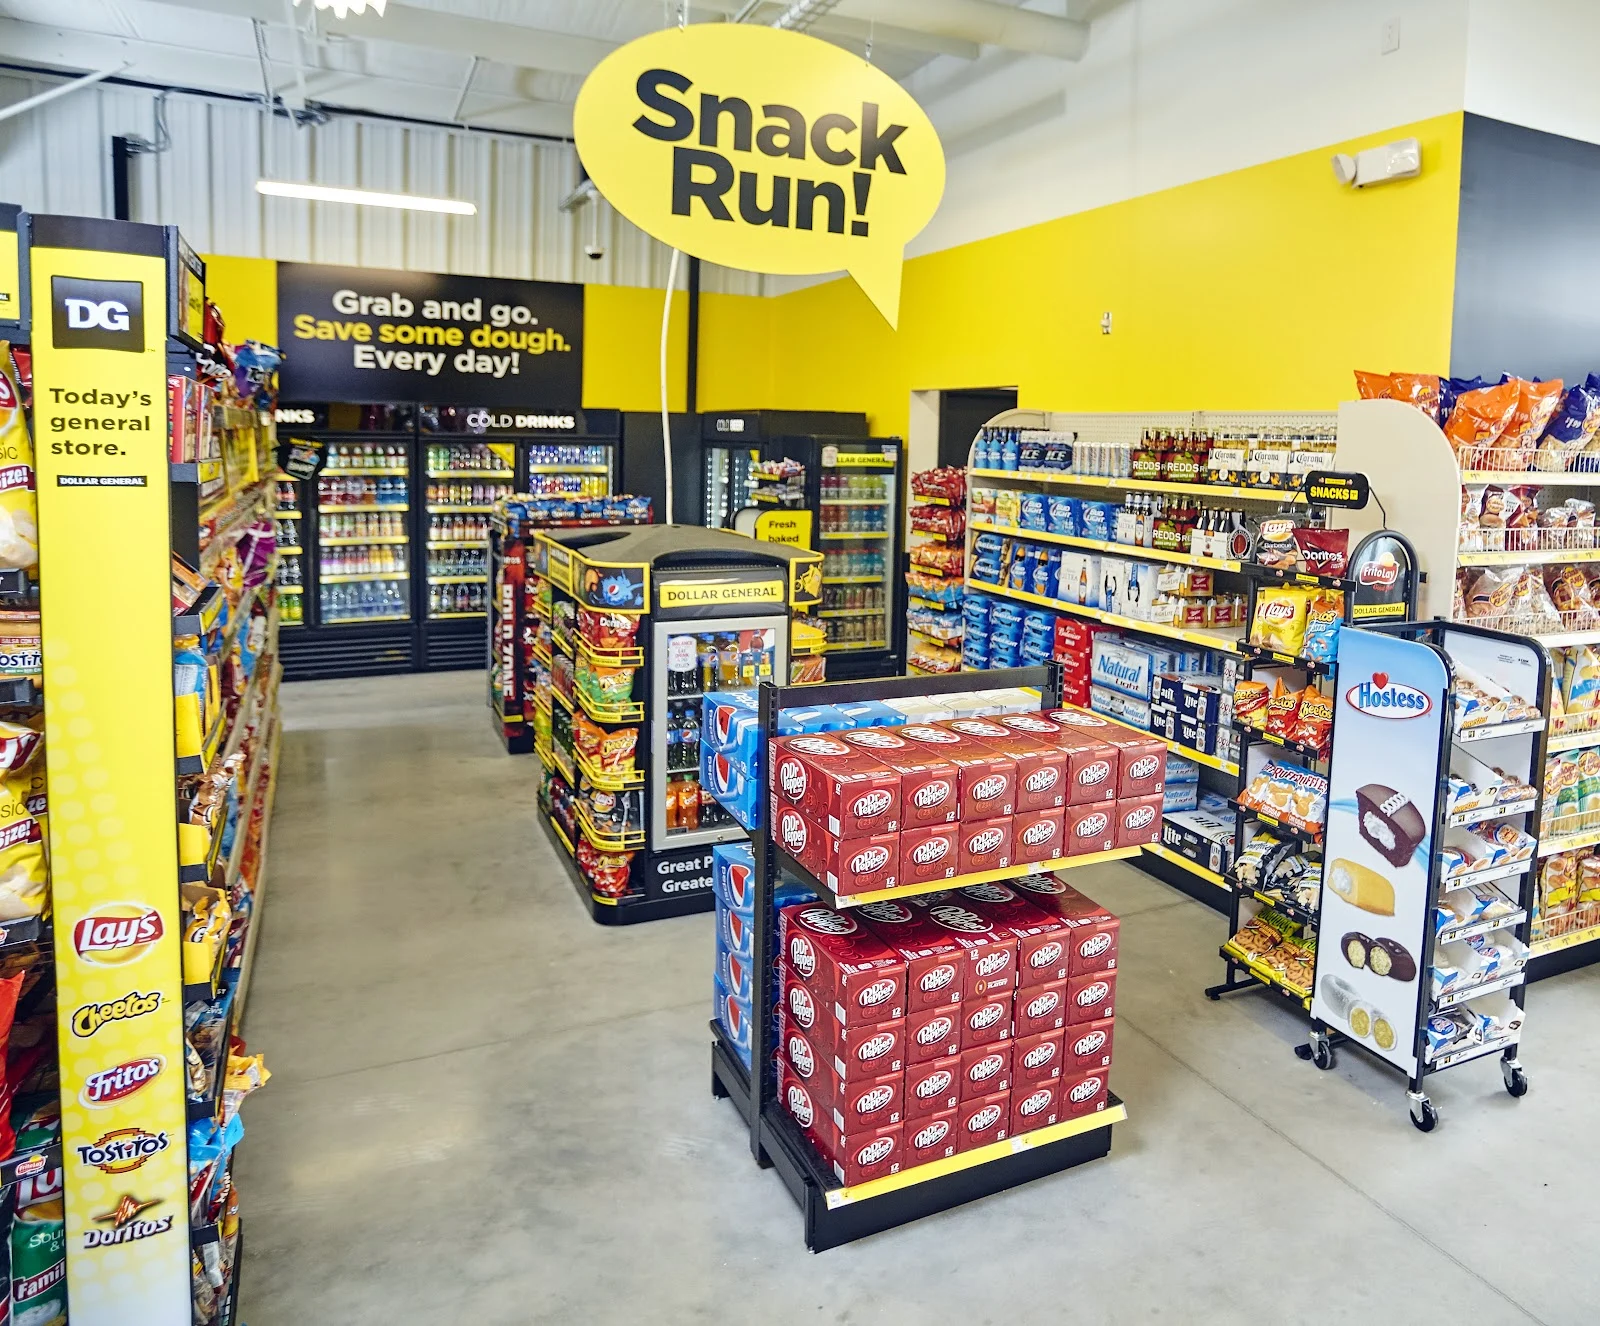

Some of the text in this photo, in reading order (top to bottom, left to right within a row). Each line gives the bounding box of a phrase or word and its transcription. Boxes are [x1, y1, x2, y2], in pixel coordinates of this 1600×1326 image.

[632, 69, 908, 175] Snack
[672, 146, 869, 238] Run!
[64, 297, 130, 331] DG
[332, 290, 538, 327] Grab and go.
[294, 314, 572, 355] Save some dough.
[353, 344, 520, 378] Every day!
[50, 388, 152, 408] Today's
[275, 408, 315, 424] NKS
[466, 413, 576, 430] COLD DRINKS
[50, 416, 150, 432] general
[51, 440, 126, 456] store.
[1020, 450, 1040, 460] ICE
[1044, 450, 1066, 460] ICE
[60, 476, 144, 486] DOLLAR GENERAL
[1310, 486, 1350, 500] SNACKS
[1026, 506, 1044, 514] LIGHT
[1027, 500, 1042, 508] BUD
[1054, 510, 1072, 518] LIGHT
[1087, 514, 1106, 522] LIGHT
[1089, 508, 1104, 516] BUD
[768, 520, 796, 529] Fresh
[768, 534, 799, 543] baked
[1264, 542, 1292, 550] Barbecue
[1302, 549, 1342, 562] Doritos
[668, 588, 777, 600] DOLLAR GENERAL
[1098, 654, 1142, 682] Natural
[1115, 678, 1140, 691] Light
[1160, 688, 1174, 700] Lite
[1359, 681, 1425, 710] Hostess
[1184, 696, 1198, 708] Lite
[1124, 706, 1146, 718] Natural
[1154, 716, 1166, 728] Lite
[1183, 728, 1196, 739] Lite
[1089, 765, 1100, 773] Dr
[1132, 760, 1156, 778] Pepper
[1140, 759, 1150, 767] Dr
[1081, 766, 1107, 784] Pepper
[926, 785, 939, 794] Dr
[976, 780, 1004, 799] Pepper
[984, 779, 996, 787] Dr
[867, 794, 880, 804] Dr
[917, 786, 947, 807] Pepper
[857, 796, 888, 817] Pepper
[888, 821, 897, 829] 12
[1035, 823, 1046, 832] Dr
[1027, 825, 1053, 844] Pepper
[1164, 826, 1182, 846] Lite
[657, 858, 701, 875] Great
[662, 877, 713, 893] Greate
[79, 912, 158, 951] Lay's
[1083, 938, 1109, 956] Pepper
[1091, 937, 1102, 945] Dr
[862, 985, 893, 1006] Pepper
[872, 983, 884, 993] Dr
[72, 992, 160, 1037] Cheetos
[1027, 1048, 1053, 1067] Pepper
[1035, 1046, 1046, 1055] Dr
[86, 1059, 160, 1101] Fritos
[917, 1127, 946, 1147] Pepper
[926, 1125, 938, 1134] Dr
[84, 1215, 174, 1248] Doritos
[18, 1261, 65, 1300] Famil
